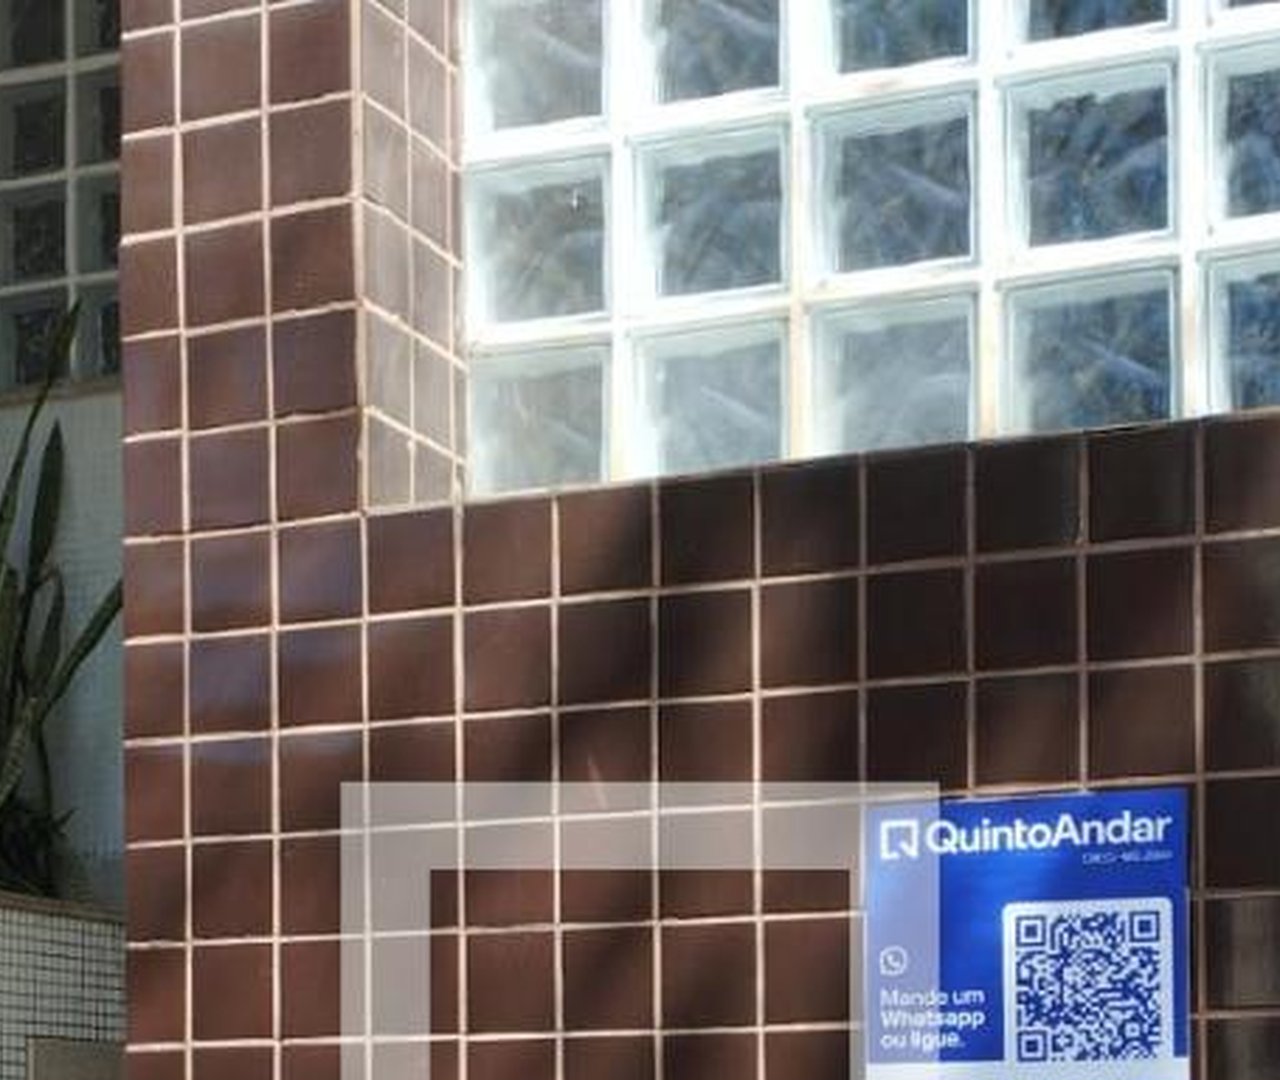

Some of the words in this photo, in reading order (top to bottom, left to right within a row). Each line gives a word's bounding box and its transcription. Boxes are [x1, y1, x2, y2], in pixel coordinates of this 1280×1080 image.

[925, 810, 1173, 855] QuintoAndar
[879, 988, 949, 1006] Mande
[952, 988, 985, 1005] um
[879, 1010, 986, 1031] Whatsapp
[879, 1033, 907, 1050] ou
